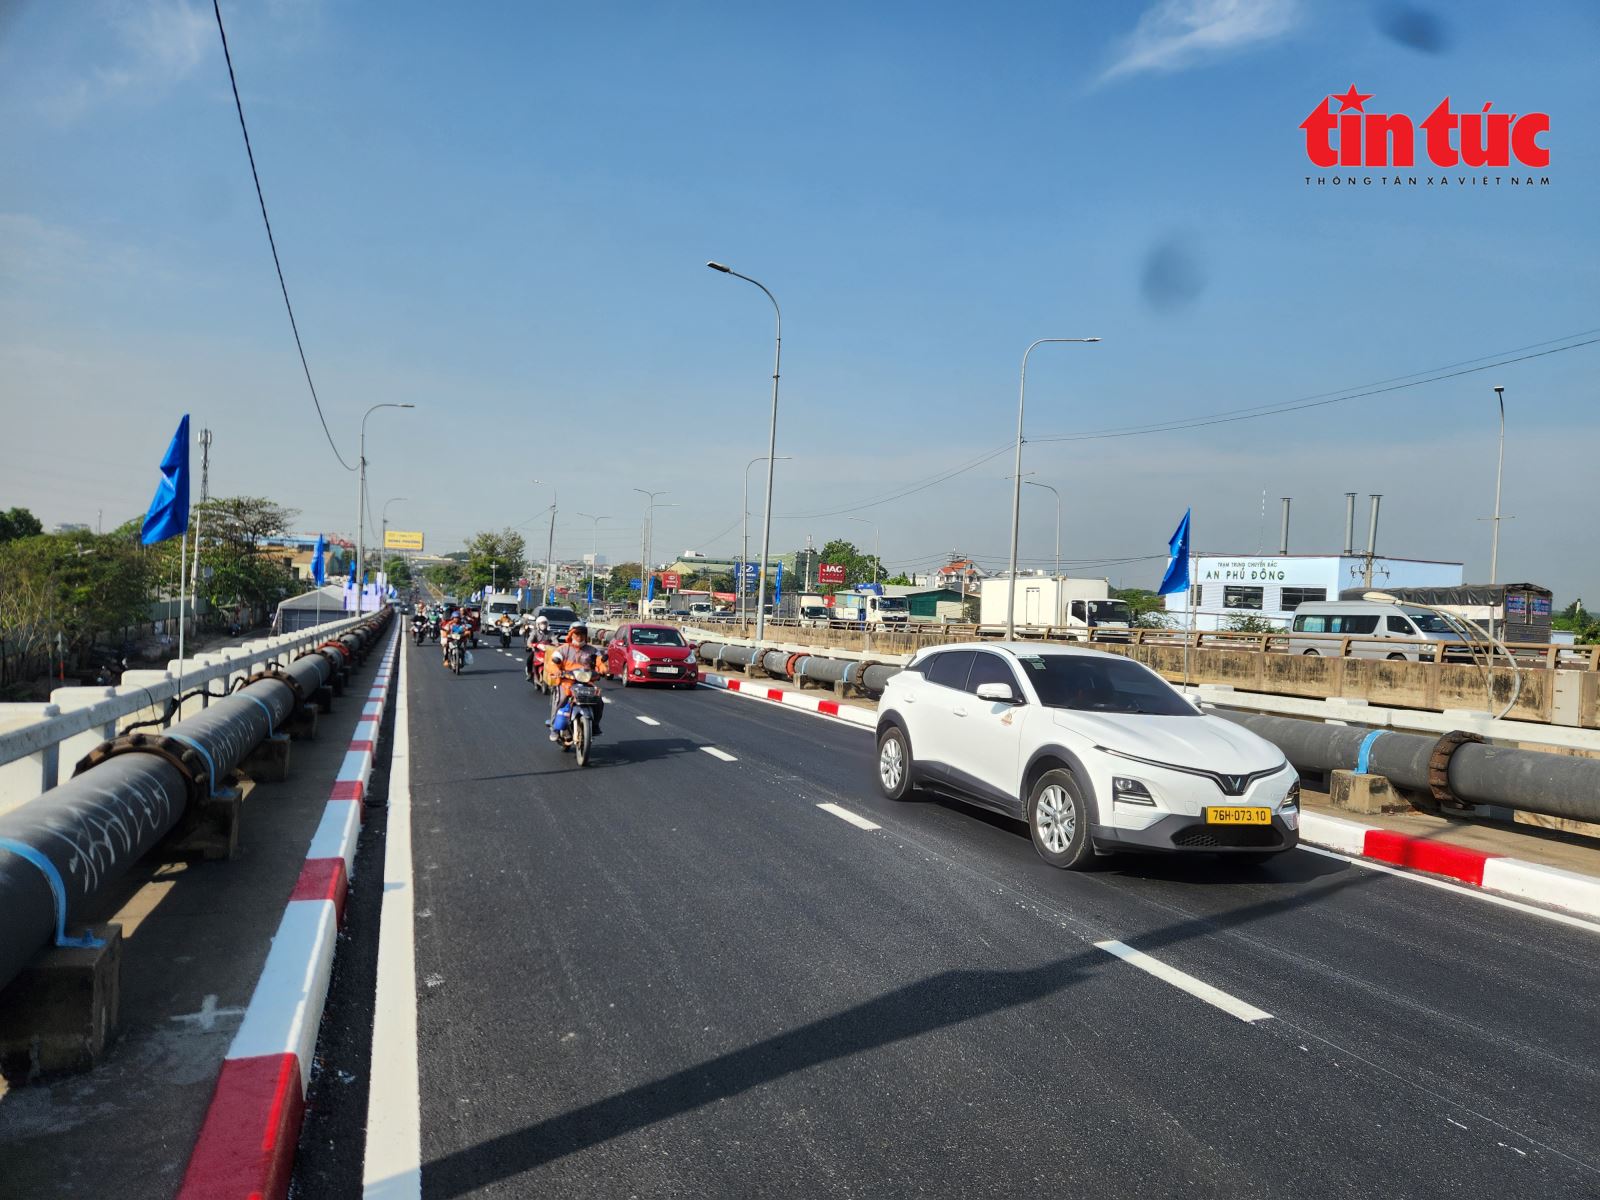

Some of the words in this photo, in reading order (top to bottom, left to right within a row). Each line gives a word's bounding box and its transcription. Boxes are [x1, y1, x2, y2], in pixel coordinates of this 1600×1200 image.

[822, 565, 843, 573] JAC
[1206, 571, 1220, 580] AN
[1226, 567, 1246, 580] PHÚ
[1251, 567, 1285, 581] ĐÔNG
